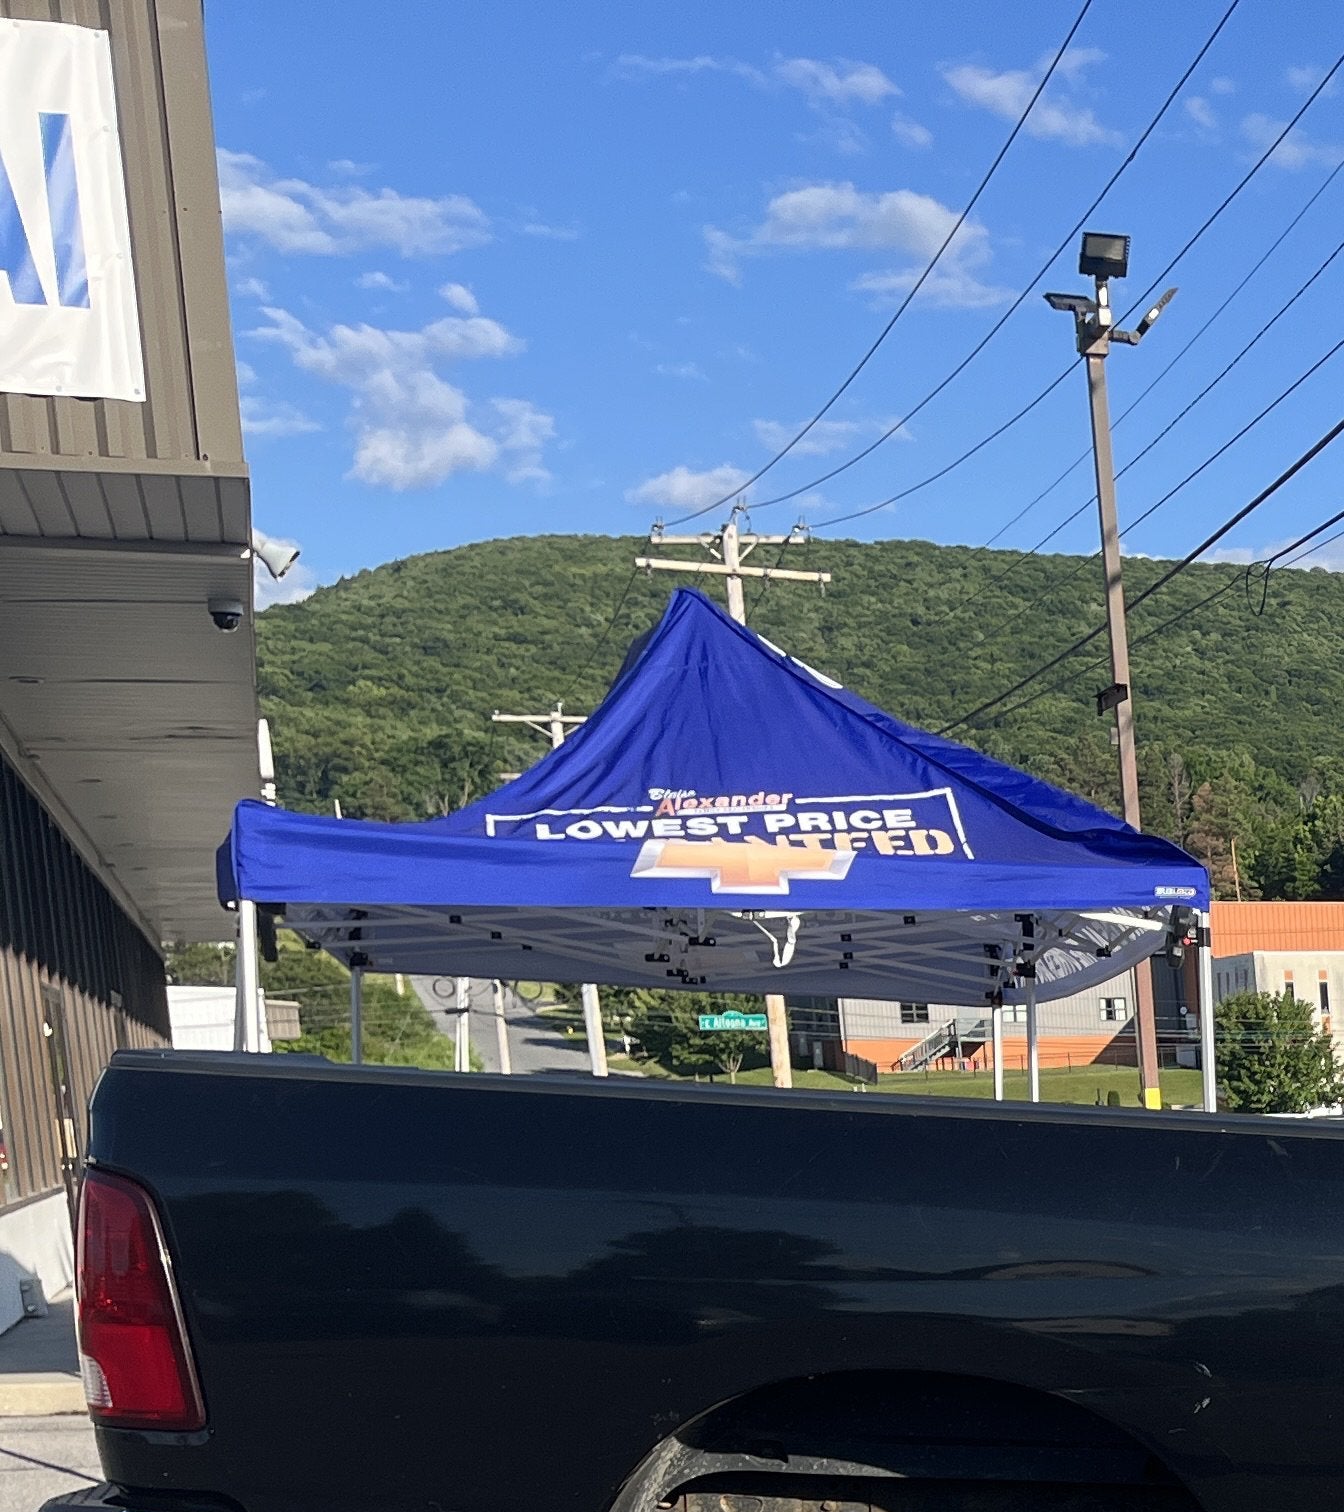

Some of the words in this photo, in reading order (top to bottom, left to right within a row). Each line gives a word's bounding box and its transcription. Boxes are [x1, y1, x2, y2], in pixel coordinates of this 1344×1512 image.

[655, 791, 793, 817] Alexander
[536, 815, 748, 841] LOWEST
[764, 808, 916, 833] PRICE
